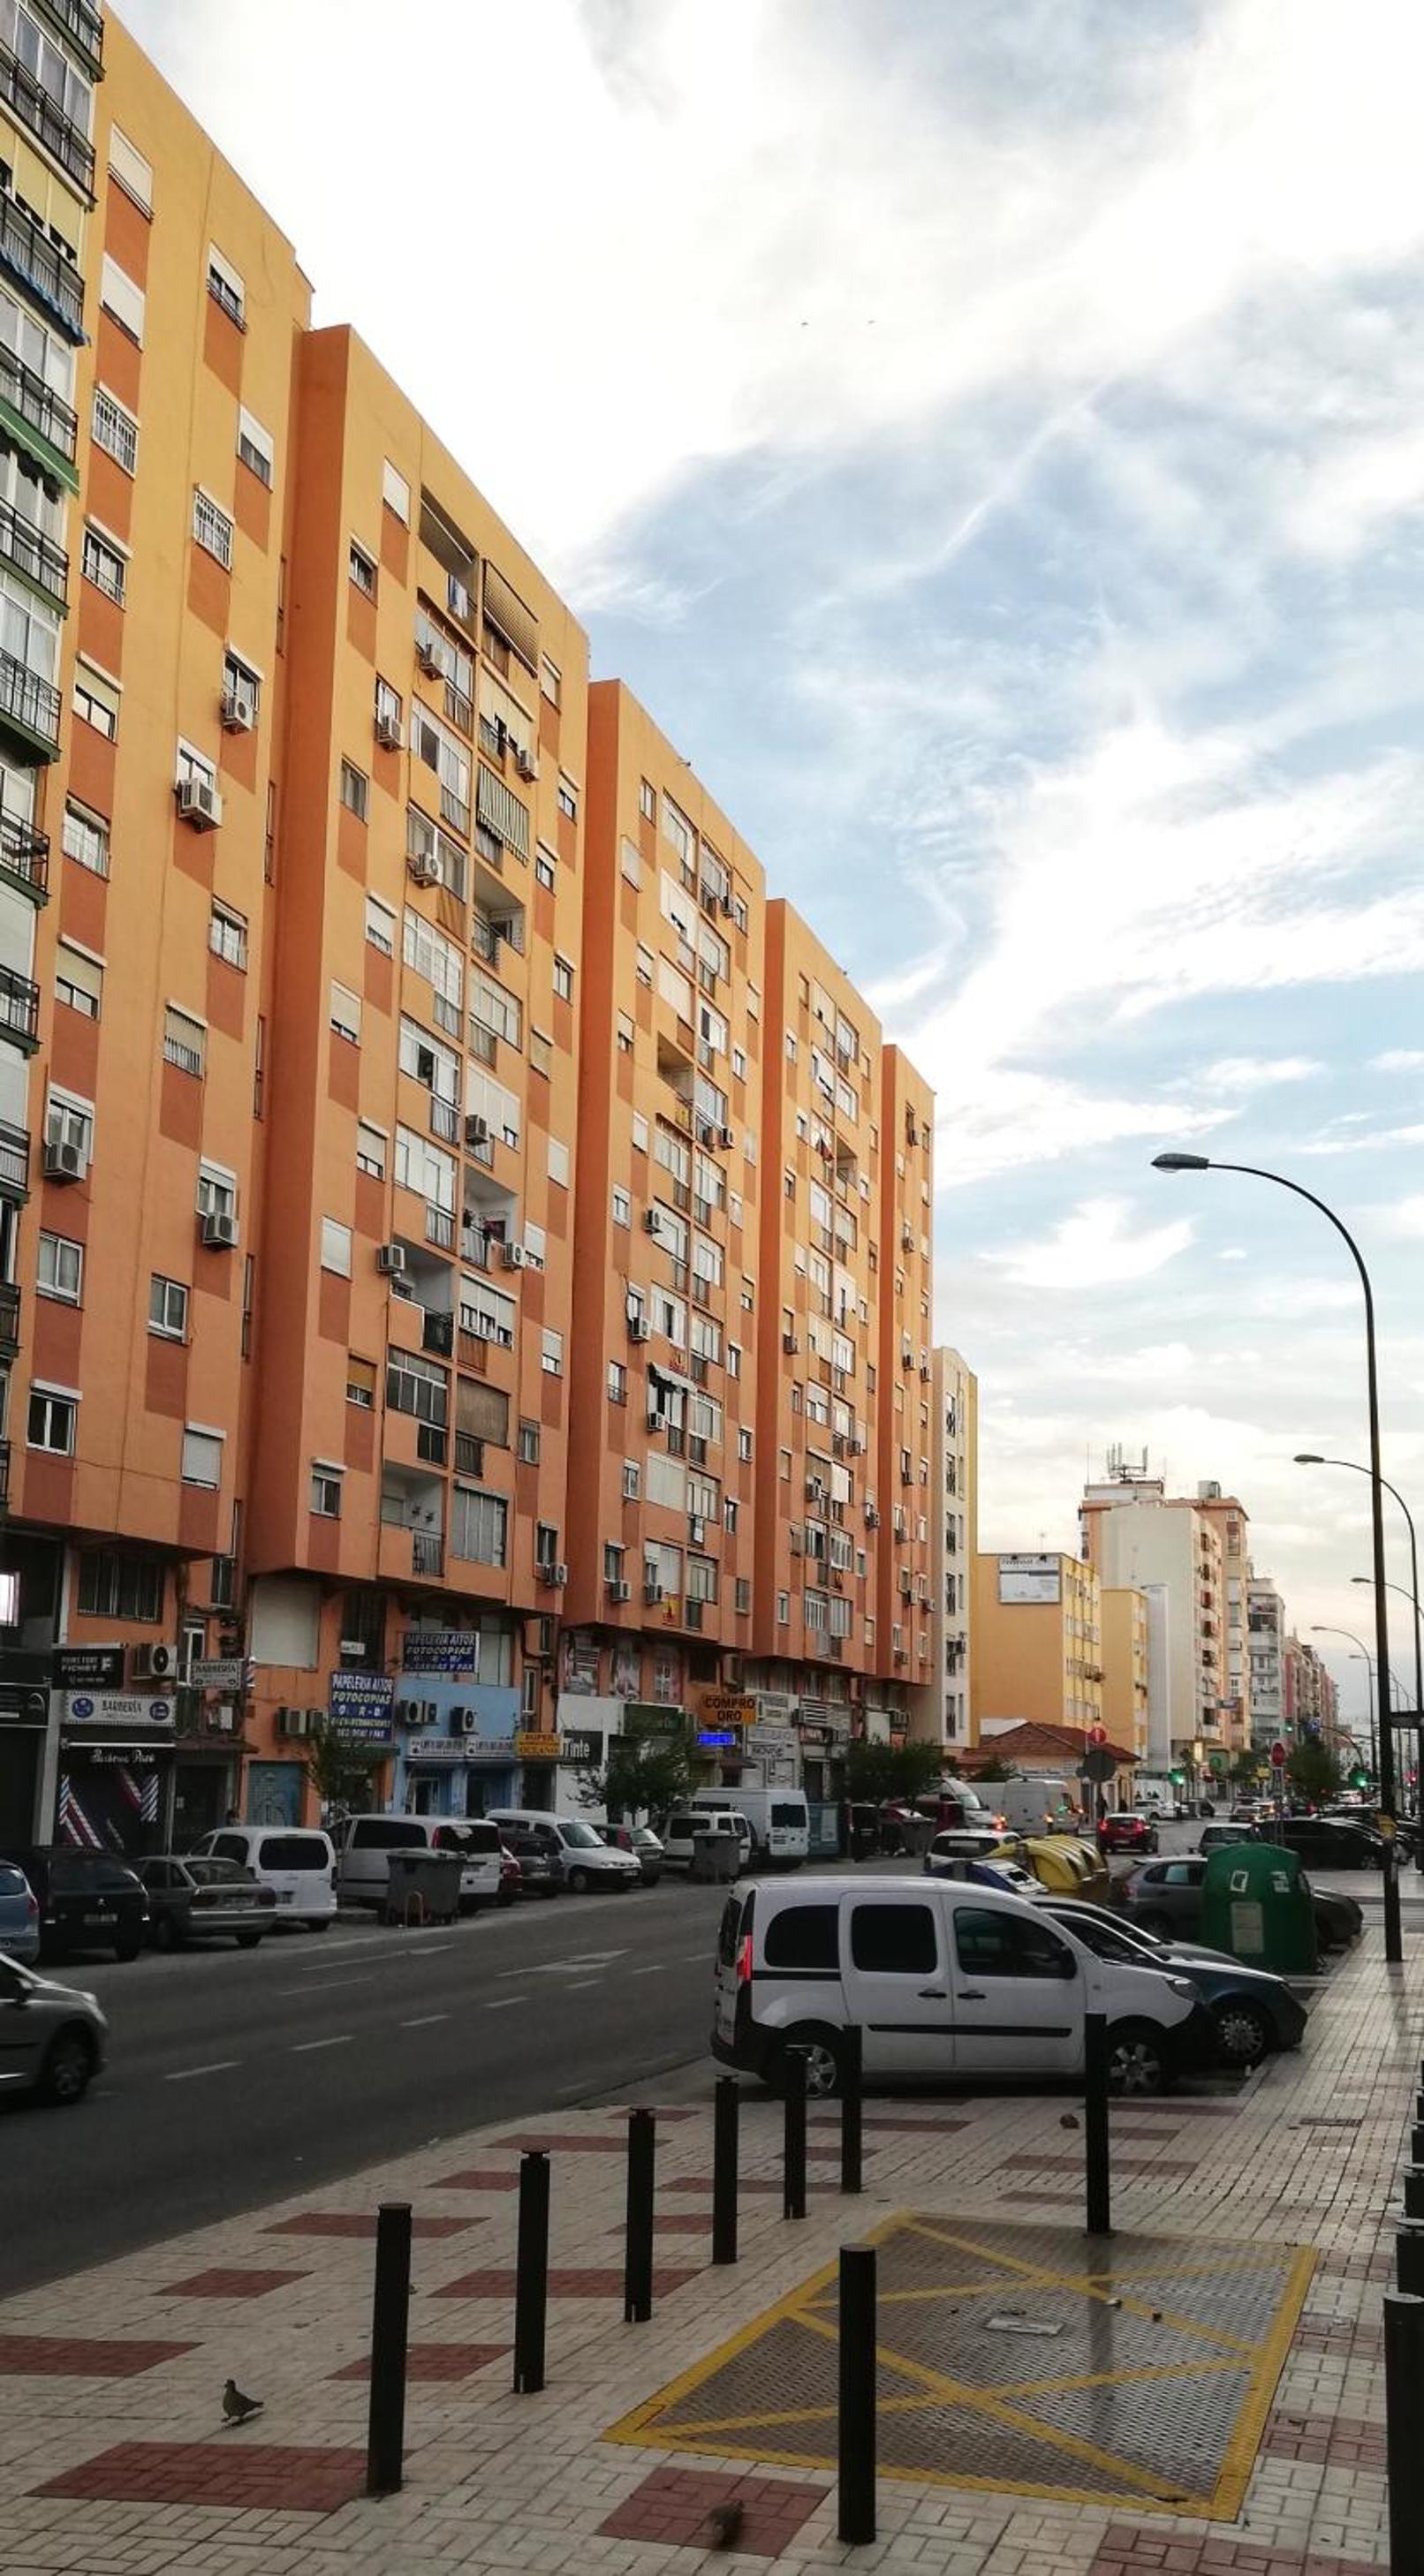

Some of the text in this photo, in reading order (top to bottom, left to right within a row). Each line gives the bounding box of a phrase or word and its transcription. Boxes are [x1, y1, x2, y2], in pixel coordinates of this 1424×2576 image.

[405, 1634, 474, 1646] PAPELERIA AITOR
[406, 1646, 473, 1655] FOTOCOPIAS
[332, 1673, 393, 1694] PAPELERIA AITOR
[332, 1690, 392, 1705] FOTOCOPIAS
[704, 1696, 756, 1710] COMPRO
[716, 1710, 742, 1722] ORO
